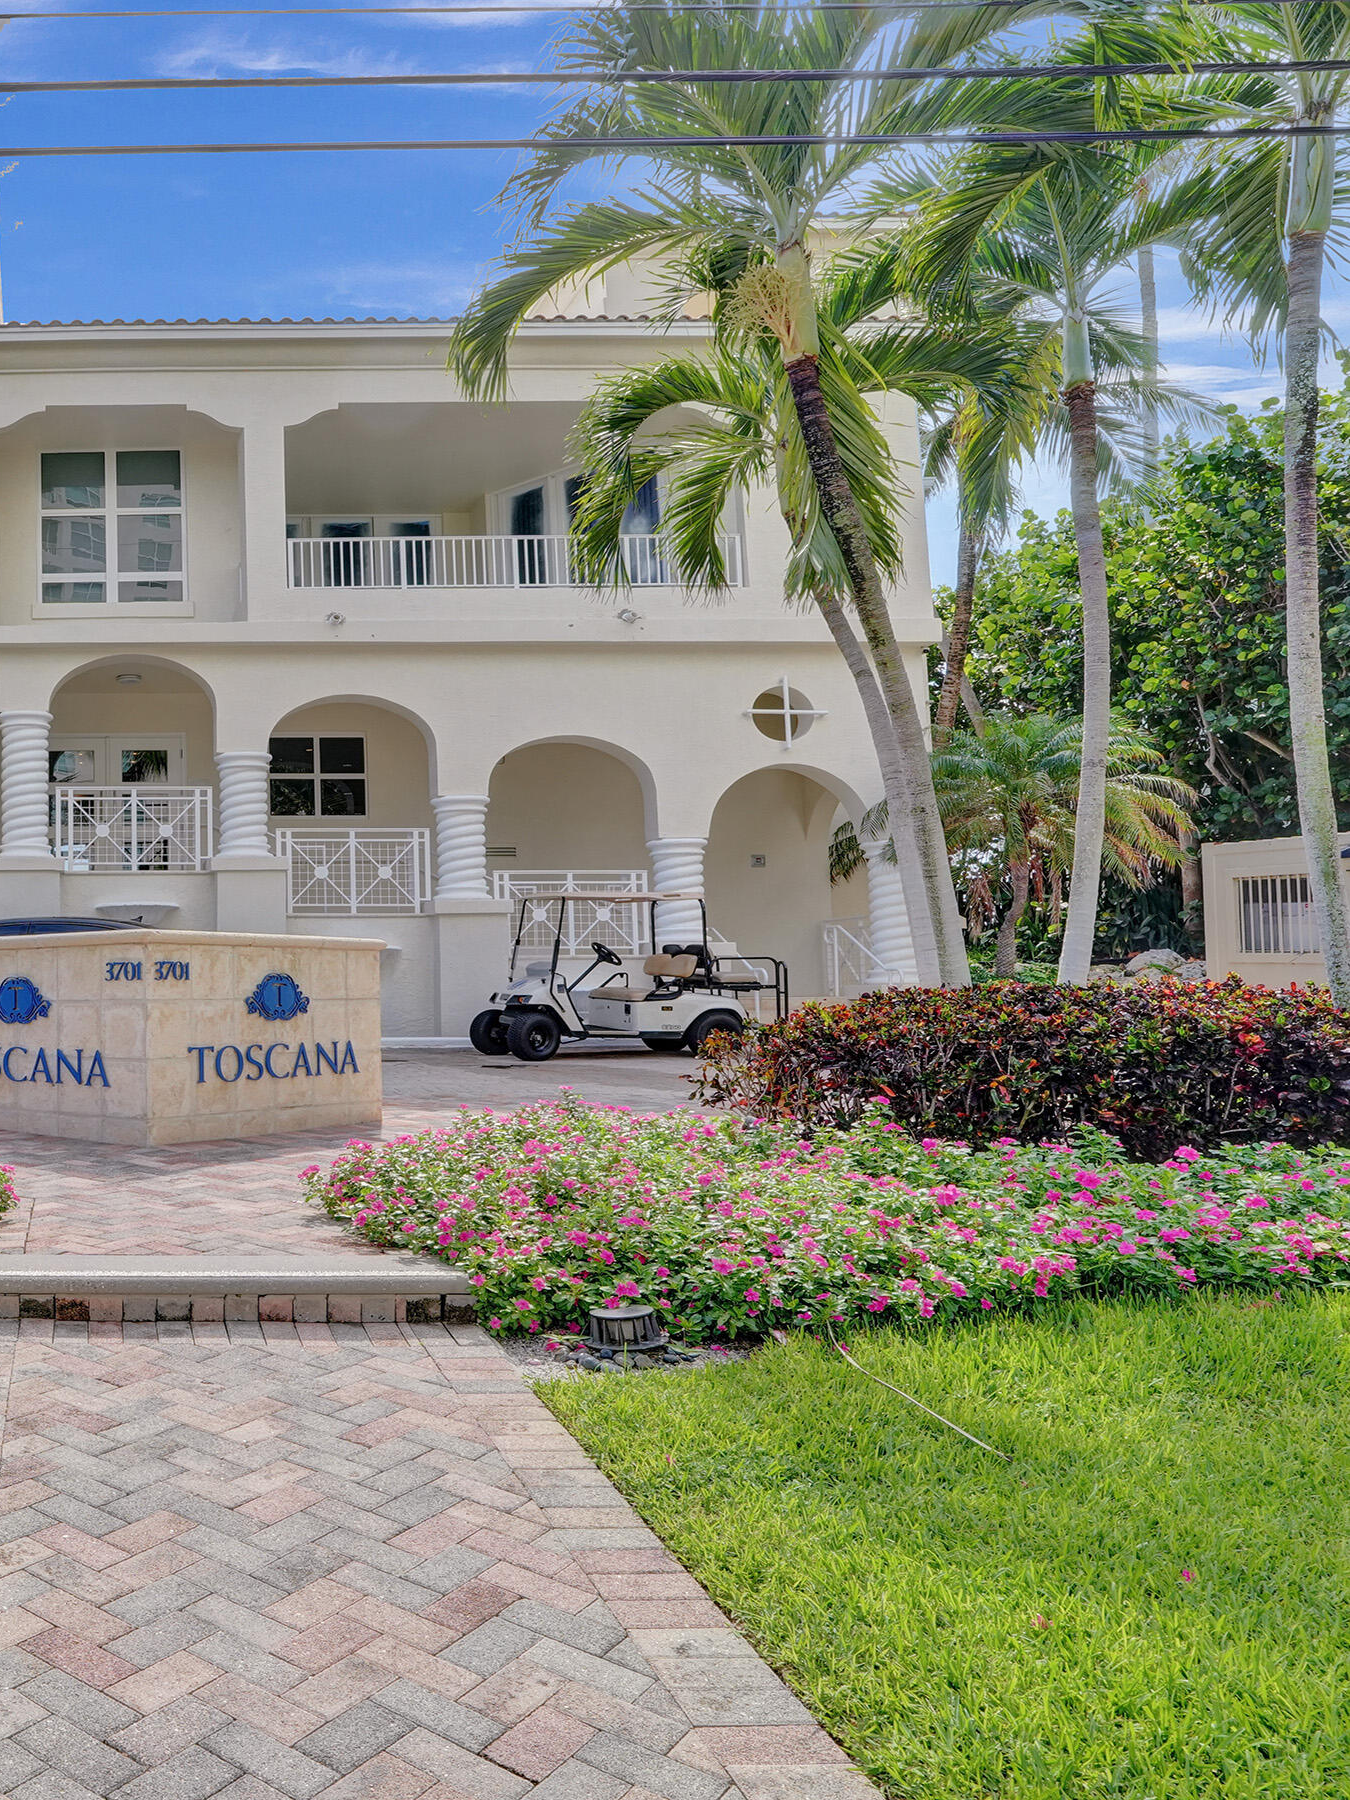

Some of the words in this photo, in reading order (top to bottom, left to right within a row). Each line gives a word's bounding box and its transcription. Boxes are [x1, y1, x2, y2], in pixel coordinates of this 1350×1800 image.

[104, 961, 143, 982] 3701
[154, 960, 190, 982] 3701
[187, 1039, 361, 1084] TOSCANA
